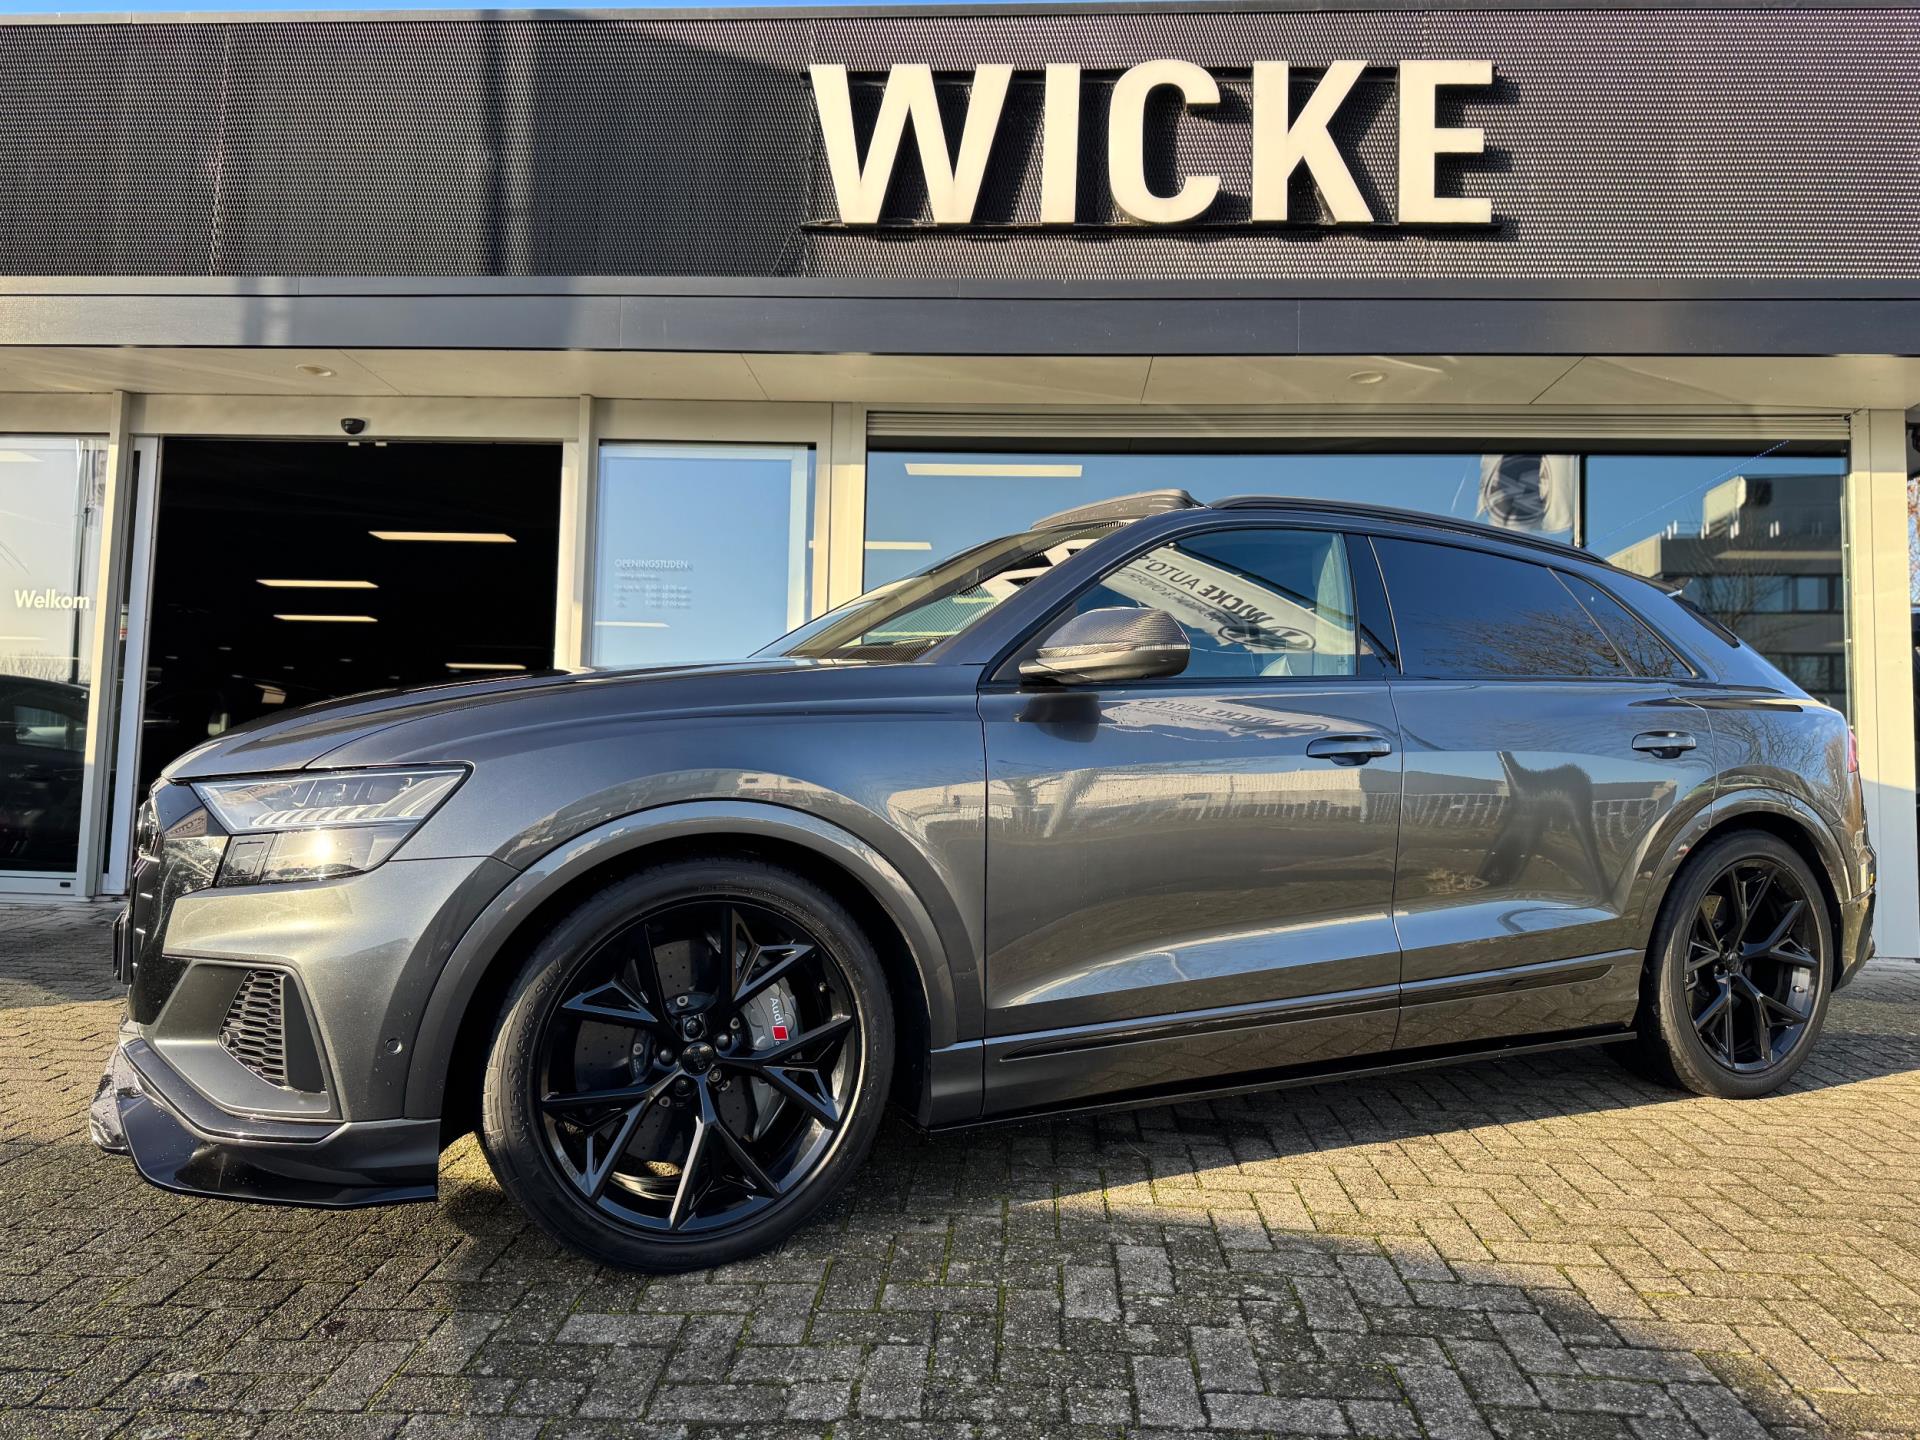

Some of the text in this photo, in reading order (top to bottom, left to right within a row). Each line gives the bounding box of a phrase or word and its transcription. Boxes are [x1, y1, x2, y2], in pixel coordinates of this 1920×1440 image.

[808, 58, 1493, 225] WICKE
[14, 589, 90, 609] Welkom
[535, 959, 563, 997] SUV
[769, 997, 785, 1025] Audi
